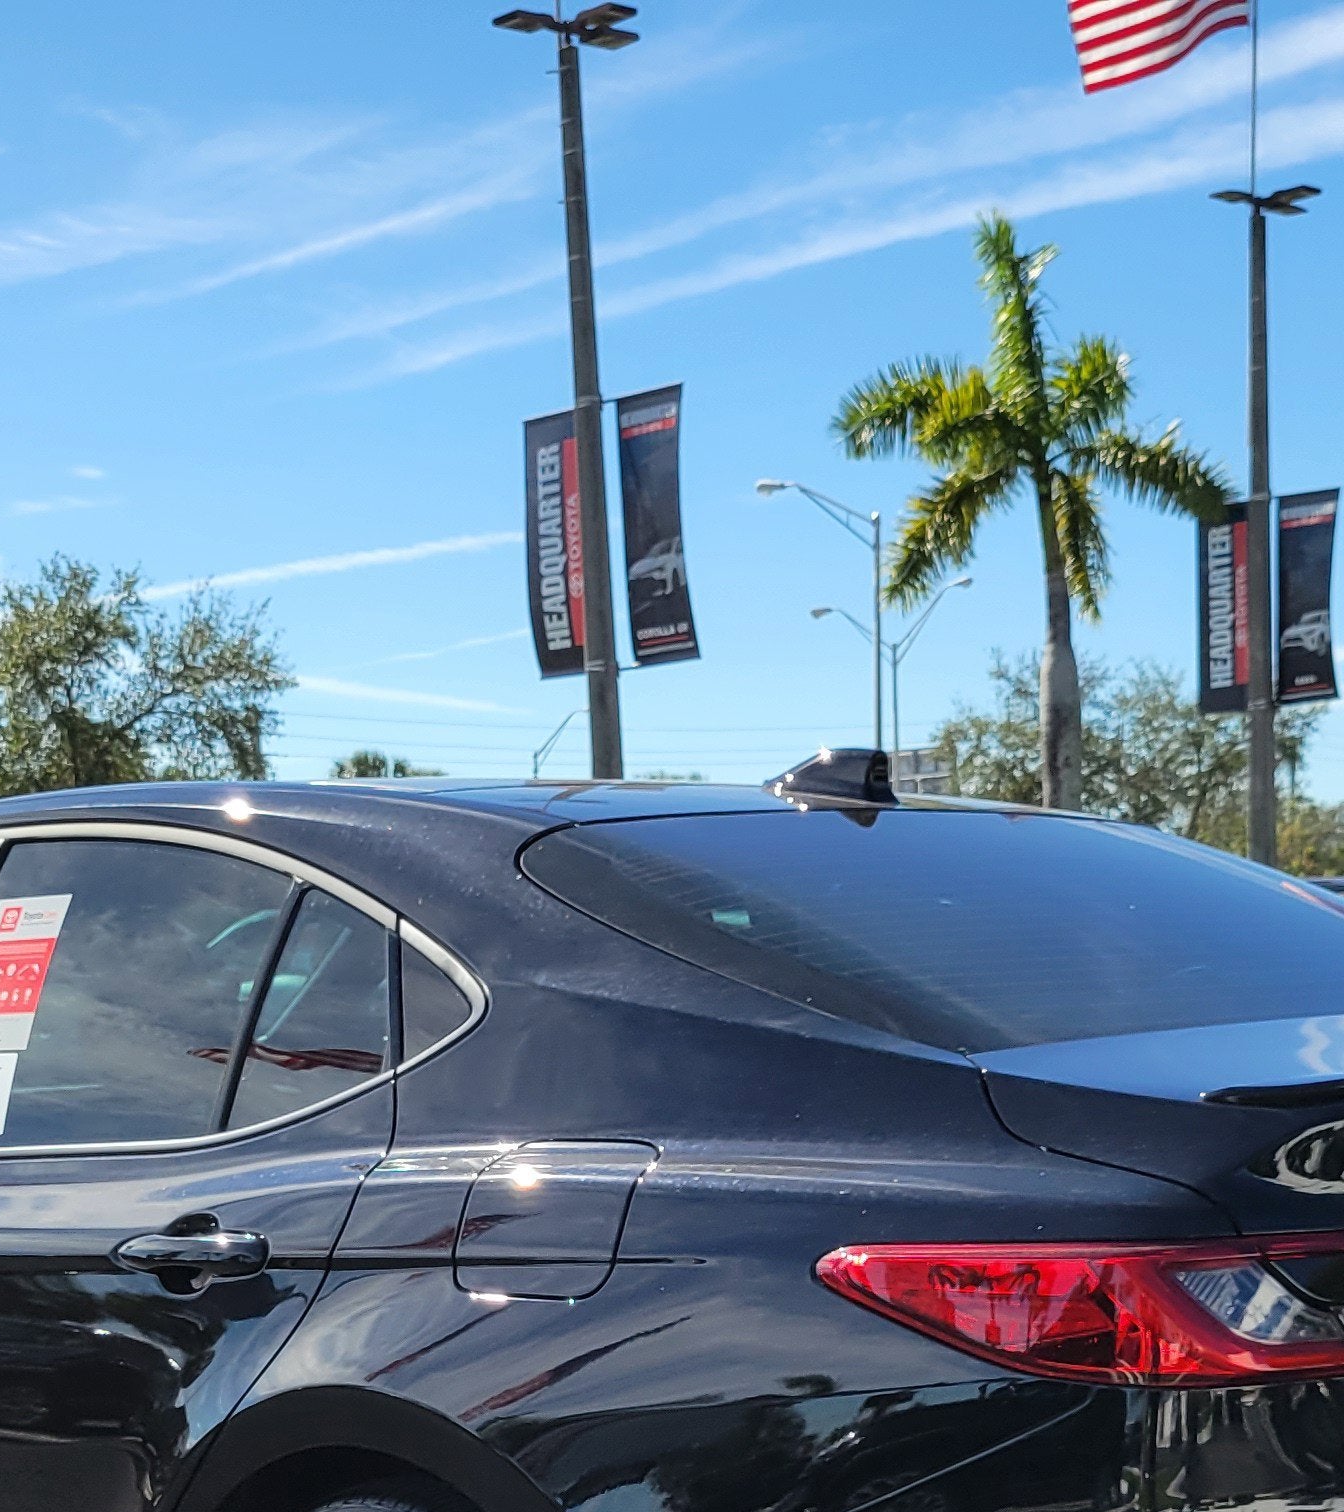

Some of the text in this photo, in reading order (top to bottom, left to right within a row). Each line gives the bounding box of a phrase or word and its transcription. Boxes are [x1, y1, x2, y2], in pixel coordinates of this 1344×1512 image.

[536, 442, 573, 650] HEADQUARTER
[564, 493, 582, 573] TOYOTA
[1208, 524, 1234, 690] HEADQUARTER
